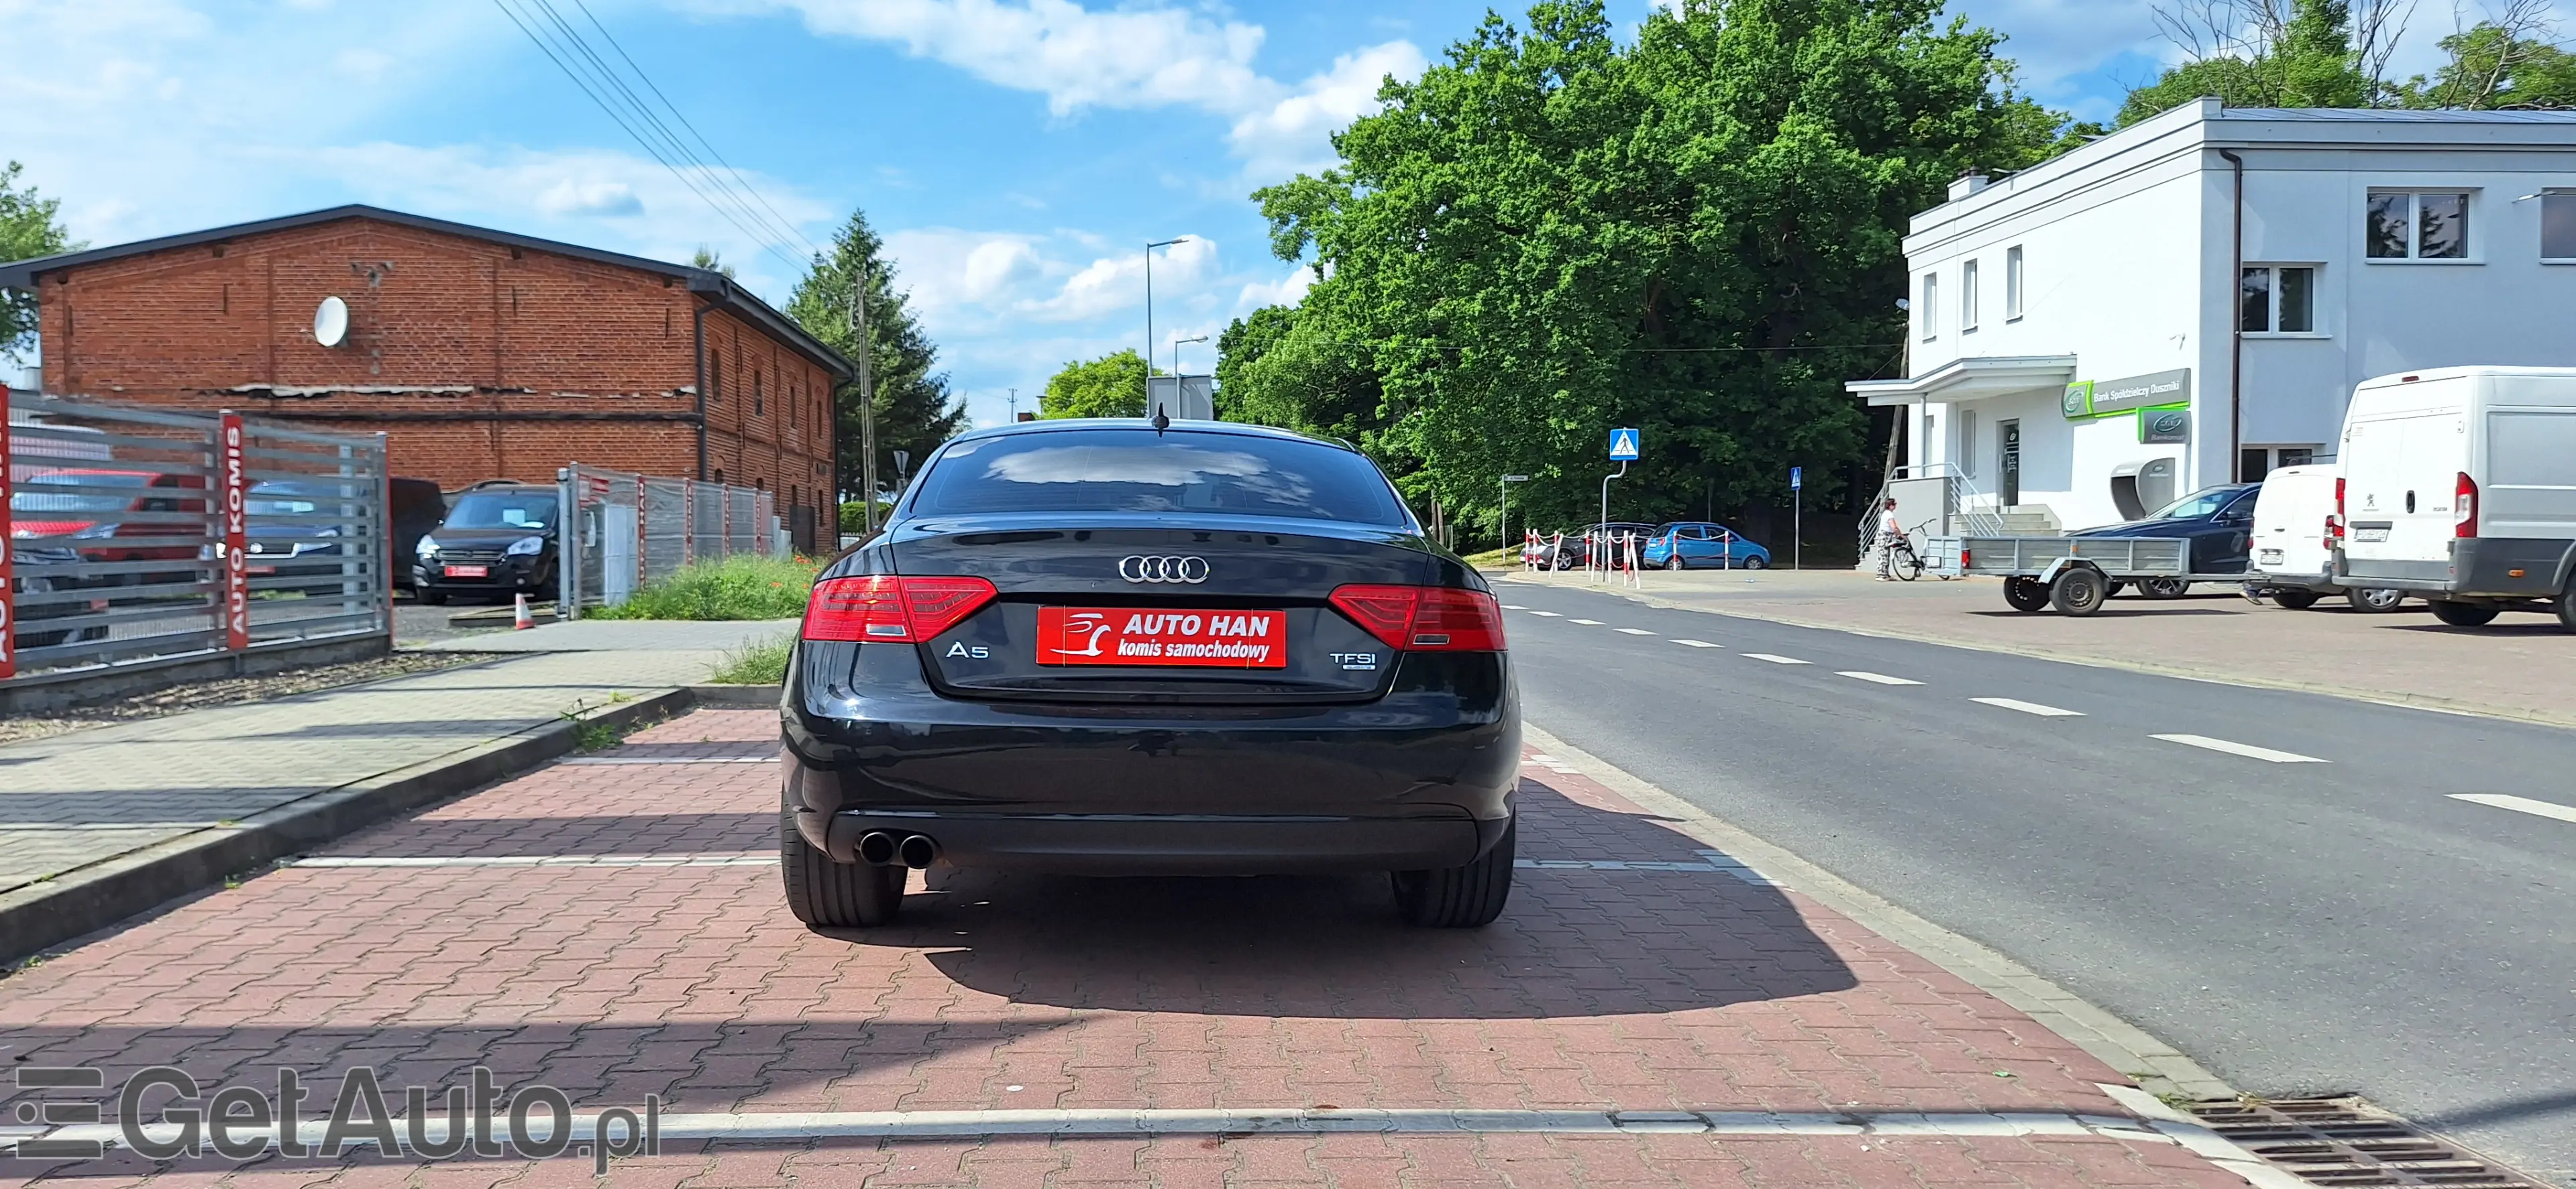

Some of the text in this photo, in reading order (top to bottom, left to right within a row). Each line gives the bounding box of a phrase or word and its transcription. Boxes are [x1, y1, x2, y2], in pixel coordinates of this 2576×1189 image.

[2094, 380, 2180, 403] Bank Spółdzielczy Duszniki
[227, 426, 245, 634] AUTO KOMIS
[1122, 614, 1270, 636] AUTO HAN
[946, 641, 989, 659] A5
[1118, 638, 1270, 663] komis samochodowy
[1330, 653, 1376, 664] TFSI
